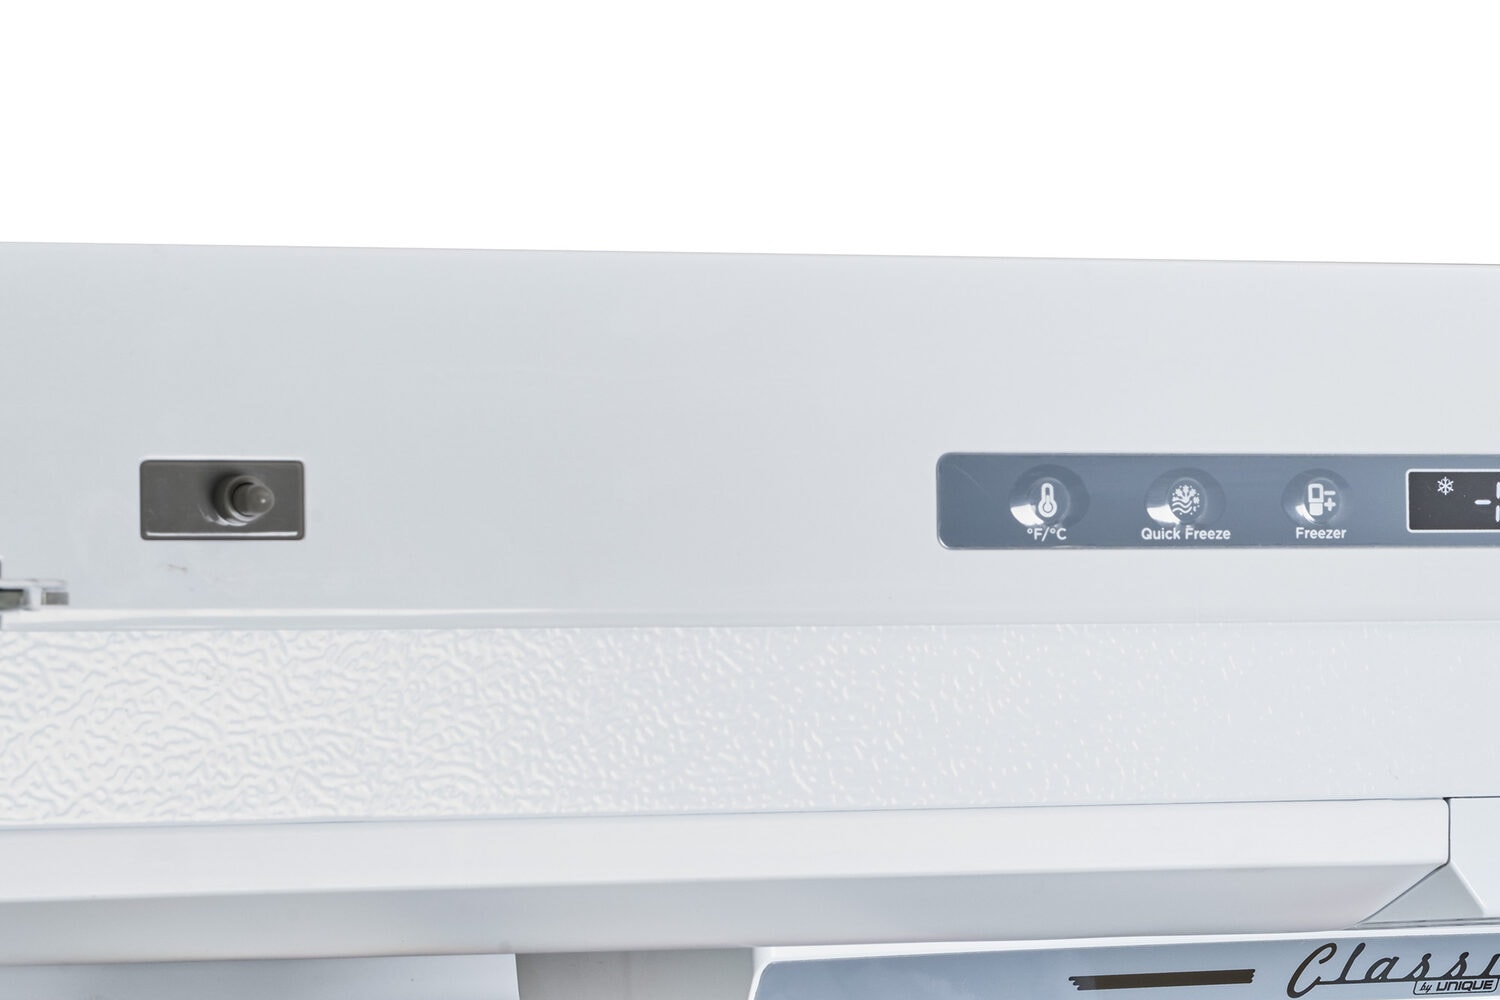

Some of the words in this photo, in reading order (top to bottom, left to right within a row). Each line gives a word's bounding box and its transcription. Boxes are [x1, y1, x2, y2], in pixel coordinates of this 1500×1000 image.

[1027, 528, 1067, 542] °F/°C
[1141, 527, 1181, 541] Quick
[1185, 527, 1231, 540] Freeze
[1296, 527, 1347, 539] Freezer
[1419, 981, 1432, 994] by
[1436, 979, 1494, 992] UNIQUE
